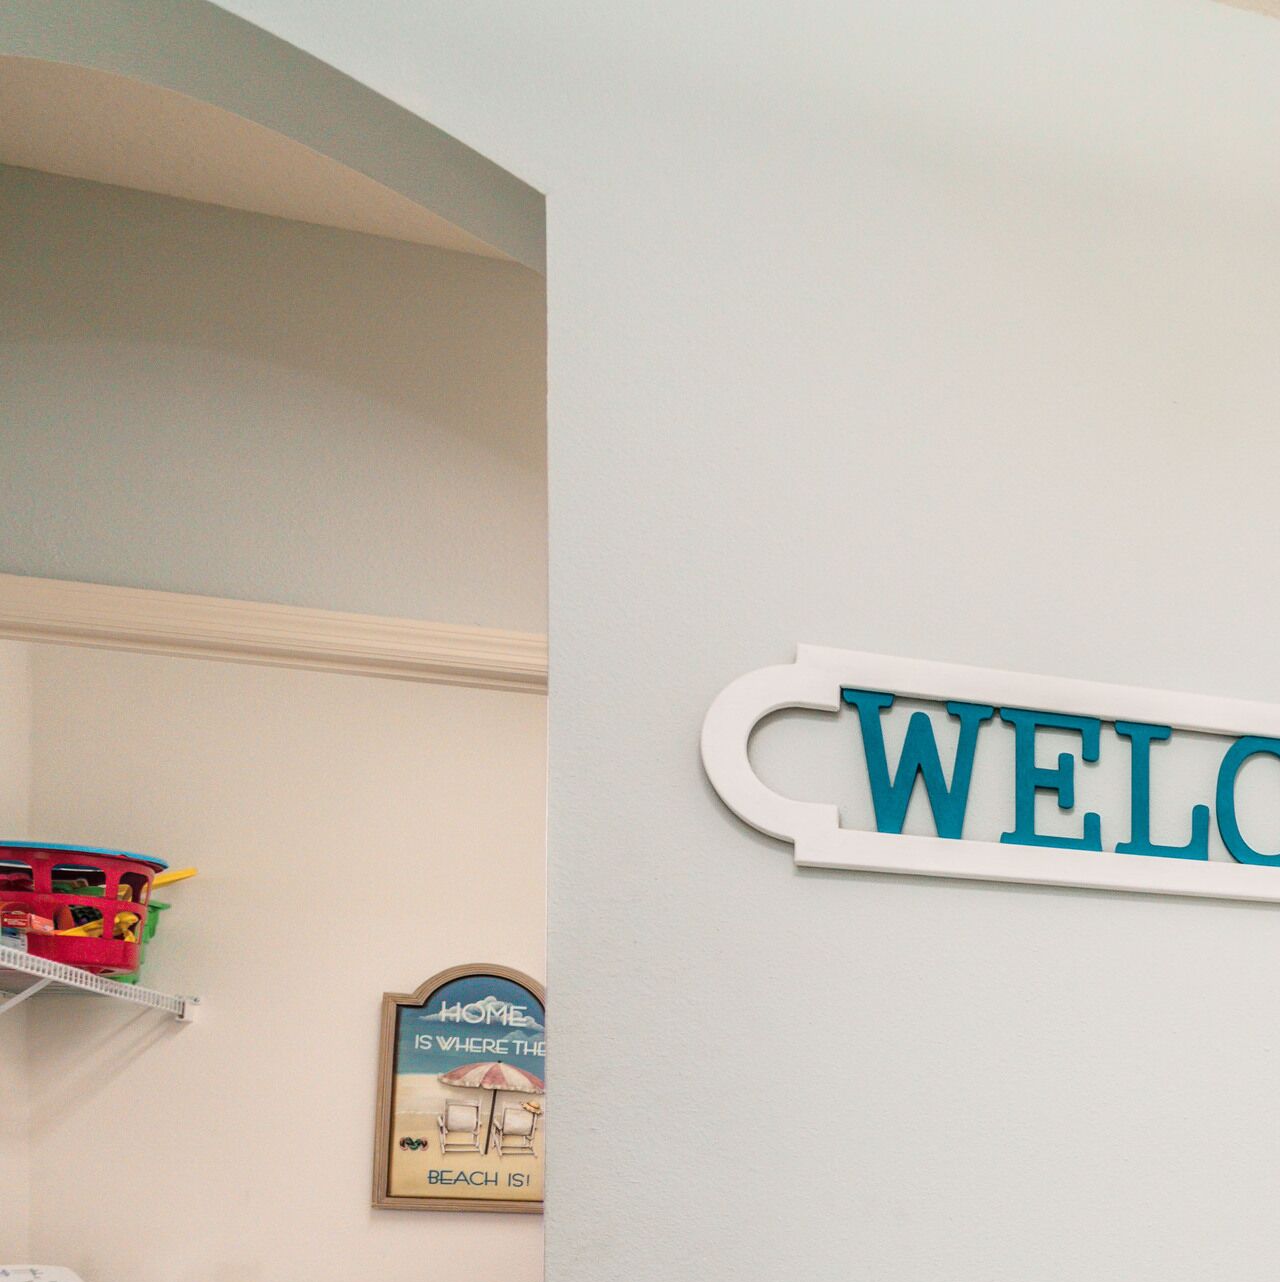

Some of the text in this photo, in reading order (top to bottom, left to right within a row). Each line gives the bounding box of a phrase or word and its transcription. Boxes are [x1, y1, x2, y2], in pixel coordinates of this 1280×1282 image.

[441, 1000, 528, 1028] HOME
[414, 1034, 546, 1057] IS WHERE THE
[427, 1169, 531, 1188] BEACH IS!
